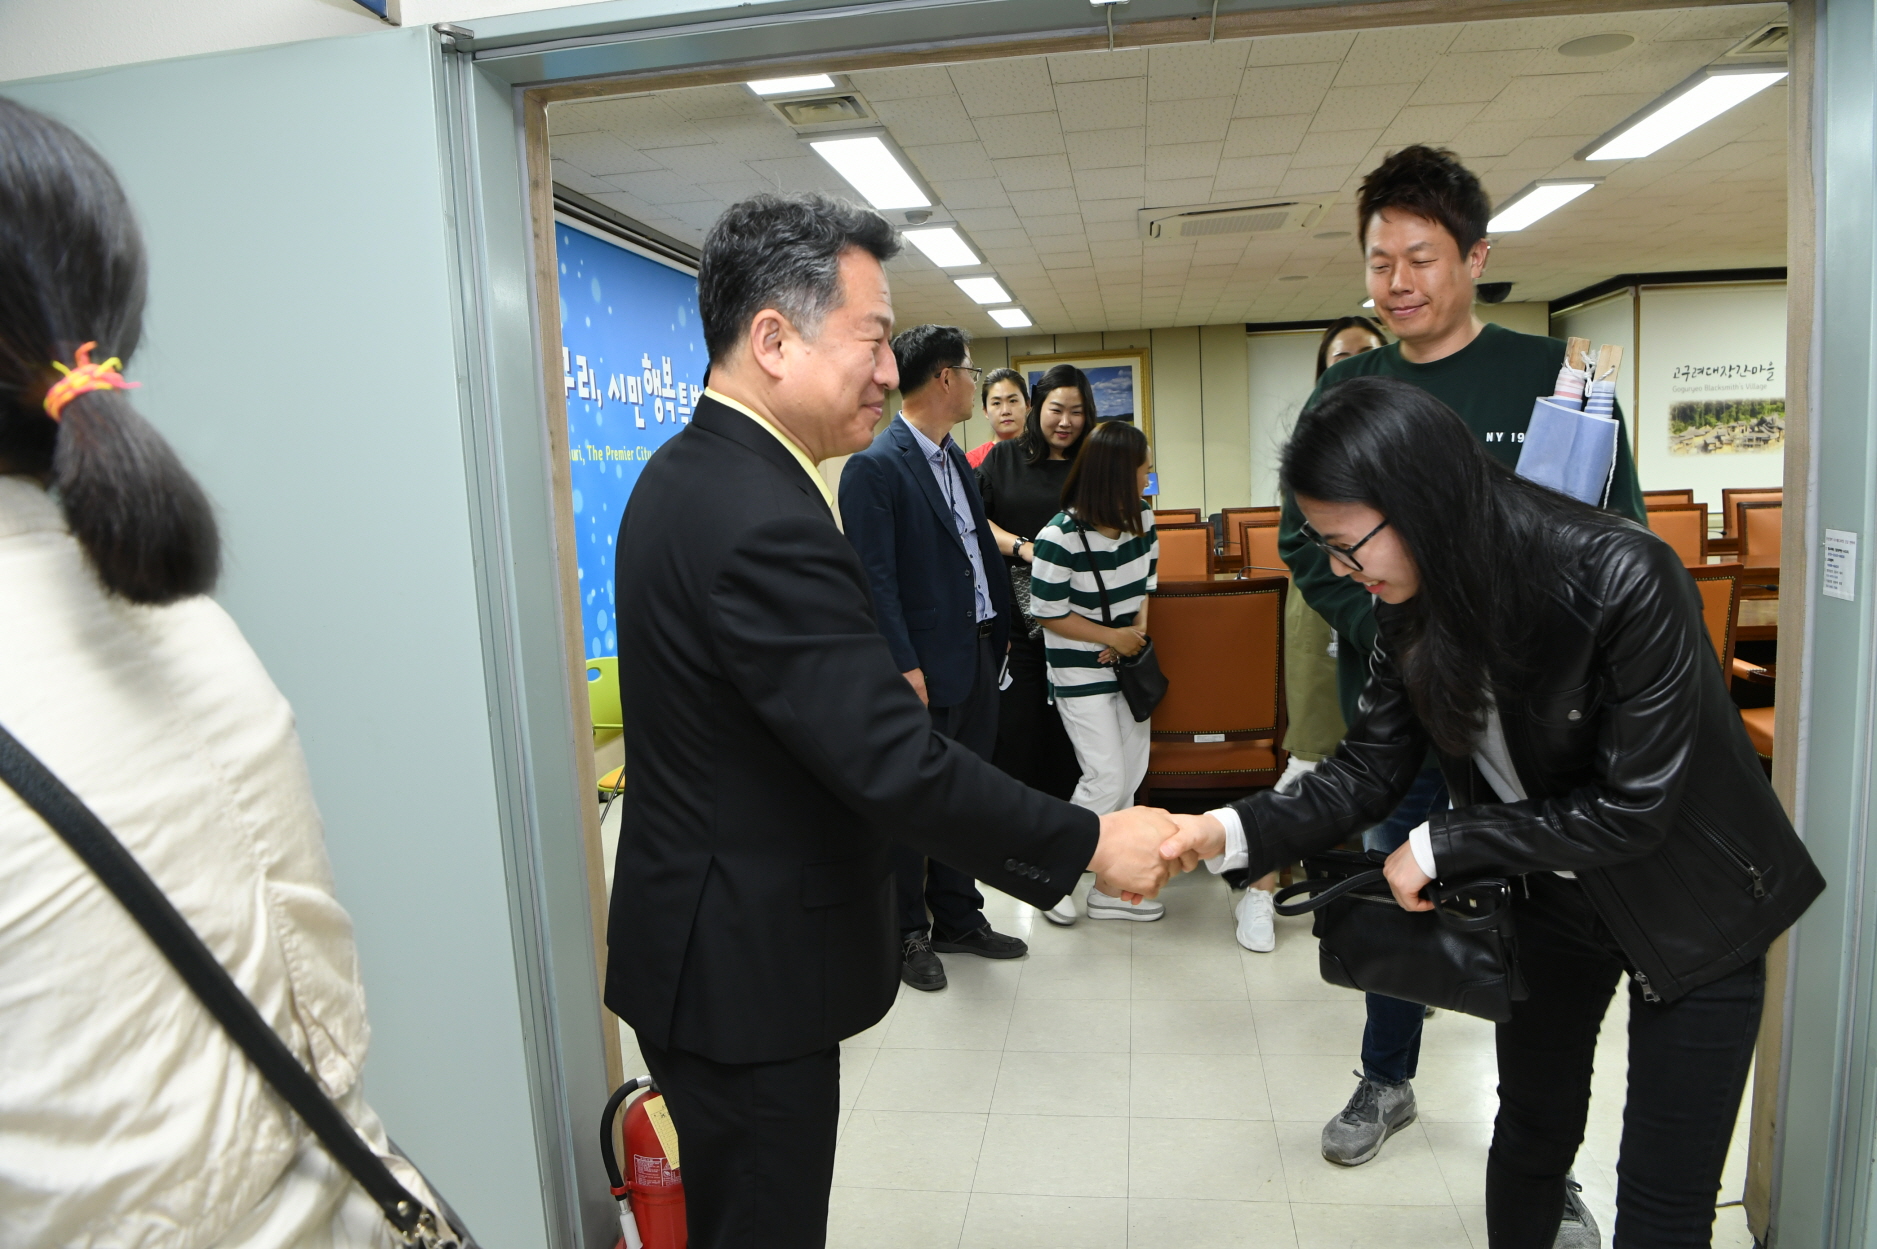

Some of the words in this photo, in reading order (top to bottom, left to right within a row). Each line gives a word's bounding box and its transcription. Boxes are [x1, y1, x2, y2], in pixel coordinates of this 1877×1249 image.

[1672, 385, 1703, 394] Goguryeo
[1704, 382, 1744, 392] Blacksmith's
[1745, 382, 1767, 392] Village
[1486, 432, 1504, 442] NY
[586, 444, 603, 461] The
[605, 445, 634, 461] Premier
